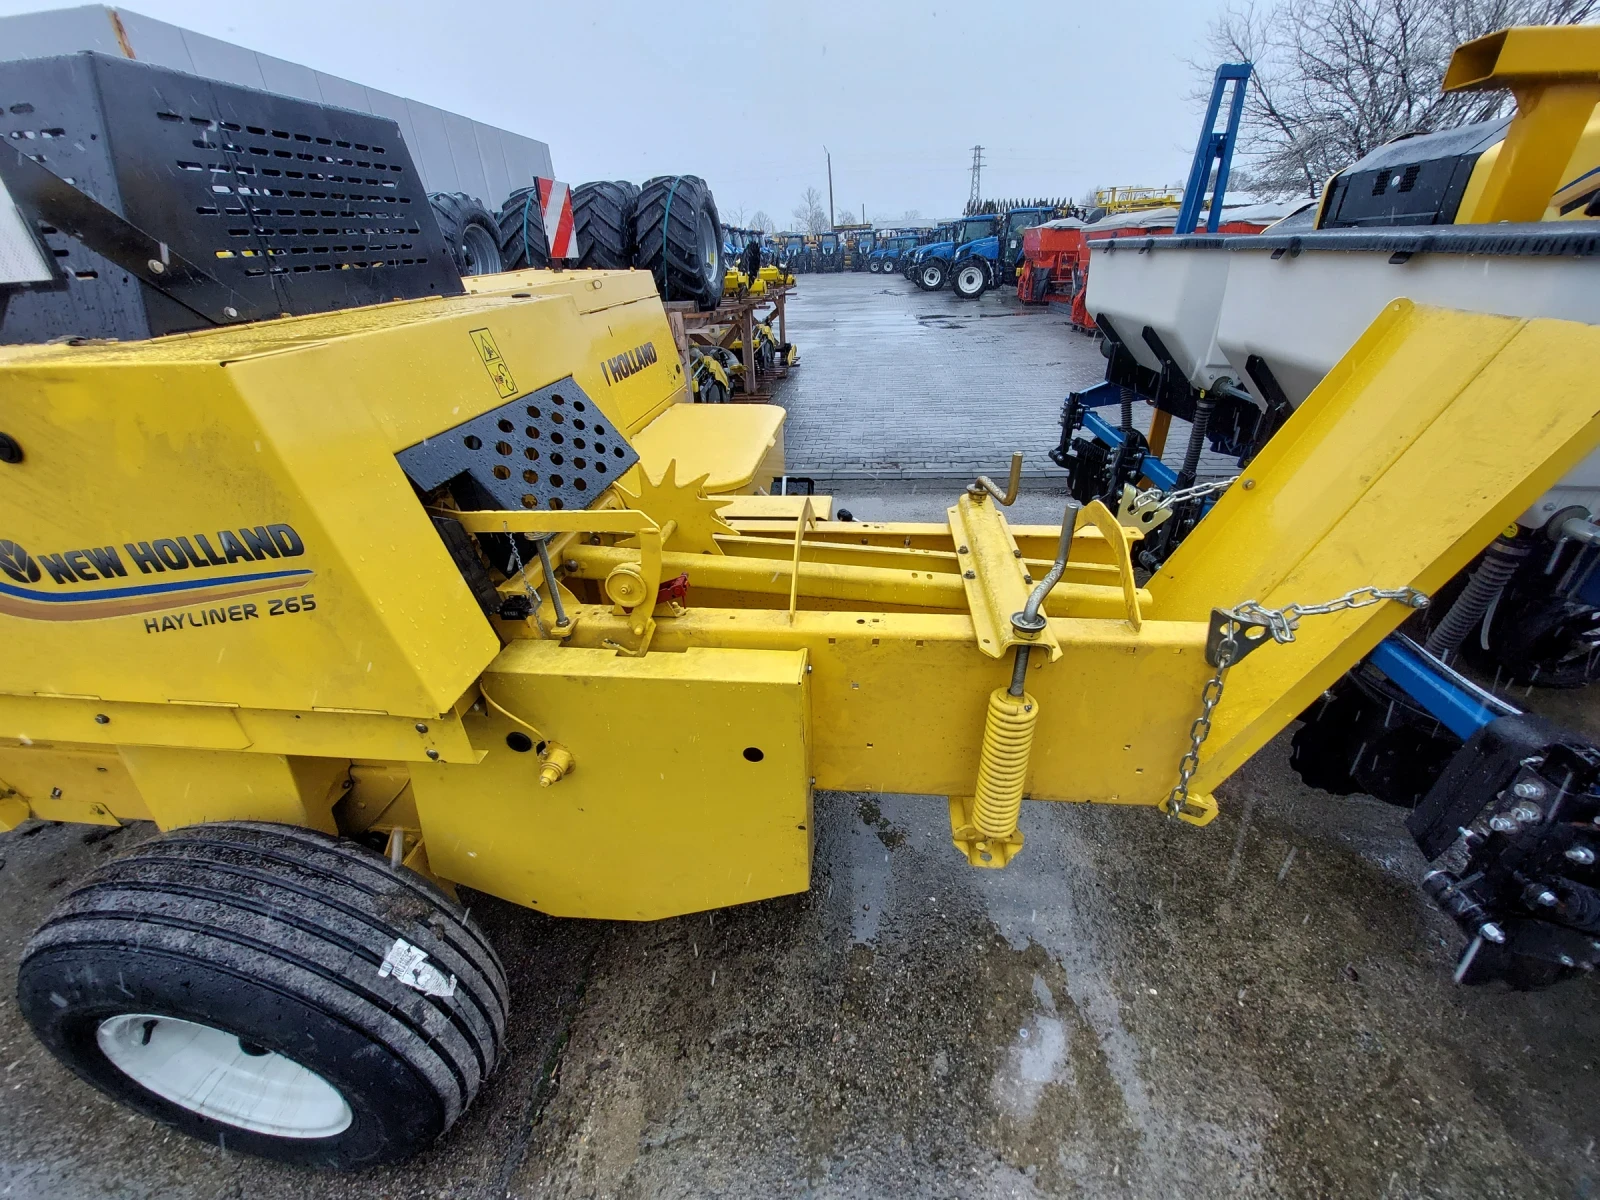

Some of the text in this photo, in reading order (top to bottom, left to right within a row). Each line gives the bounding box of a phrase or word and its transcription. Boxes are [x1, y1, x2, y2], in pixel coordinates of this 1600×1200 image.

[607, 341, 658, 384] HOLLAND
[37, 523, 305, 584] NEW HOLLAND
[144, 594, 317, 634] HAYLINER 265
